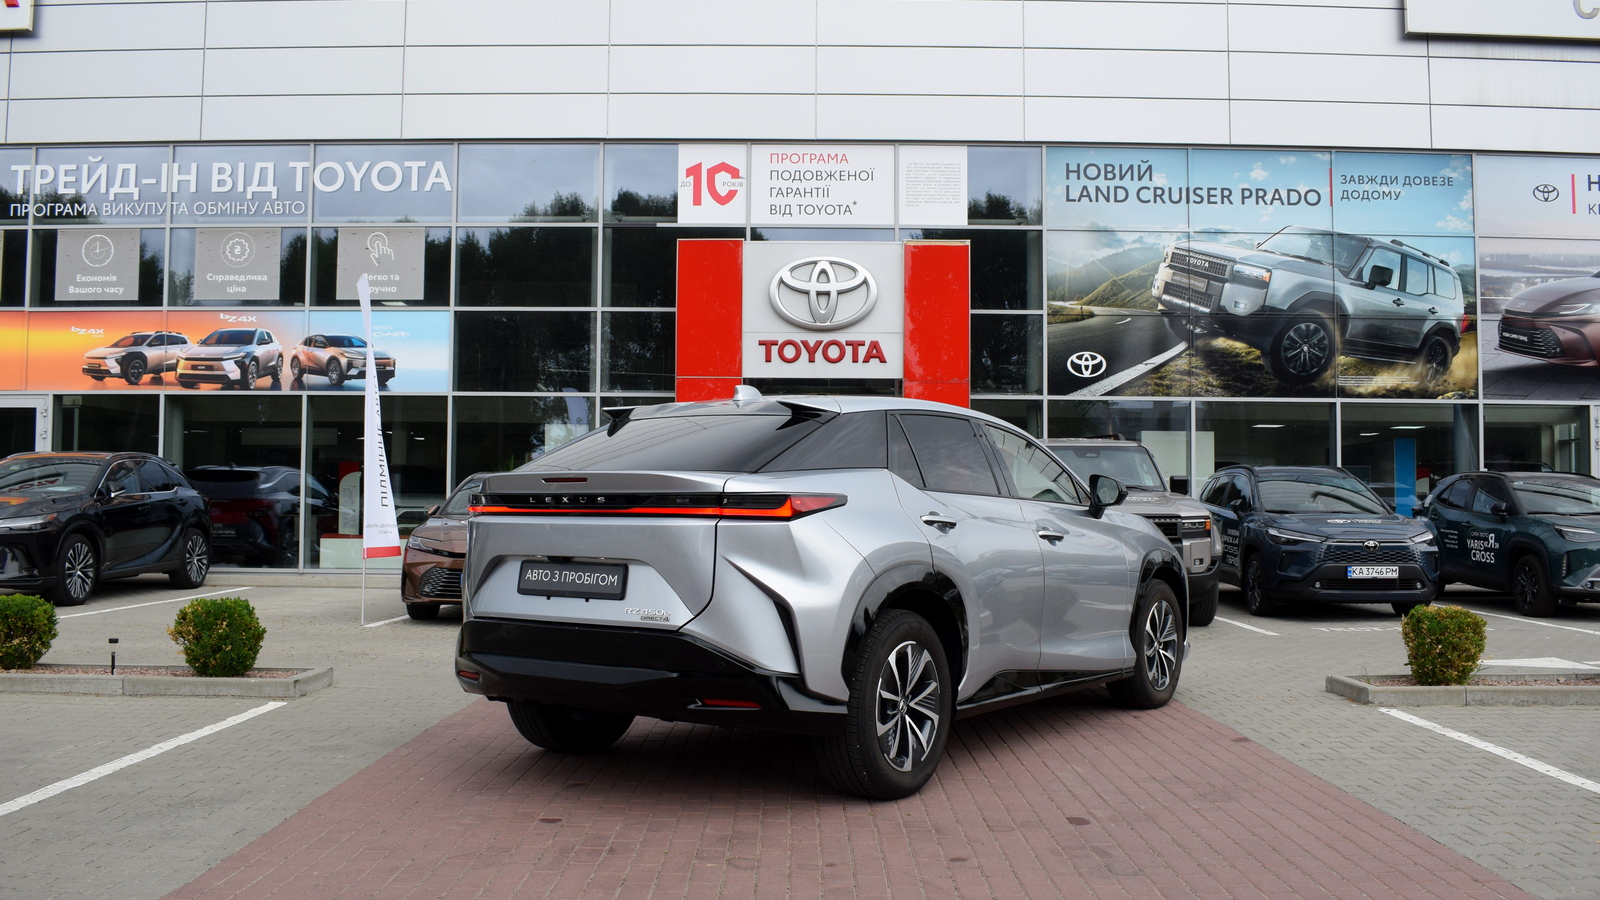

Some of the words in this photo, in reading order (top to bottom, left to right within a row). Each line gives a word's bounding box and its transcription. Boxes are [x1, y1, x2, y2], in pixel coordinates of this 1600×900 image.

[770, 153, 849, 164] ПРОГРАМА
[10, 156, 198, 200] ТРЕЙД-ІН
[212, 162, 278, 200] ВІД
[289, 161, 453, 192] TOYOTA
[770, 168, 875, 184] ПОДОВЖЕНОЇ
[1066, 160, 1153, 182] НОВИЙ
[1340, 174, 1398, 187] ЗАВЖДИ
[1402, 176, 1454, 188] ДОВЕЗЕ
[770, 184, 830, 198] ГАРАНТІЇ
[1066, 185, 1130, 203] LAND
[1136, 186, 1234, 204] CRUISER
[1241, 188, 1322, 206] PRADO
[1340, 190, 1402, 202] ДОДОМУ
[10, 203, 98, 217] ПРОГРАМА
[102, 202, 168, 216] ВИКУПУ
[171, 202, 188, 215] ТА
[194, 201, 258, 216] ОБМІНУ
[262, 201, 306, 214] АВТО
[770, 204, 792, 218] ВІД
[1186, 257, 1208, 268] TOYOTA
[206, 272, 268, 282] Справедлива
[69, 286, 101, 294] Вашого
[226, 284, 246, 294] ціна
[369, 286, 396, 294] ручно
[758, 339, 887, 364] TOYOTA
[1471, 550, 1494, 564] CROSS
[525, 569, 550, 581] АВТО
[562, 572, 618, 586] ПРОБІГОМ
